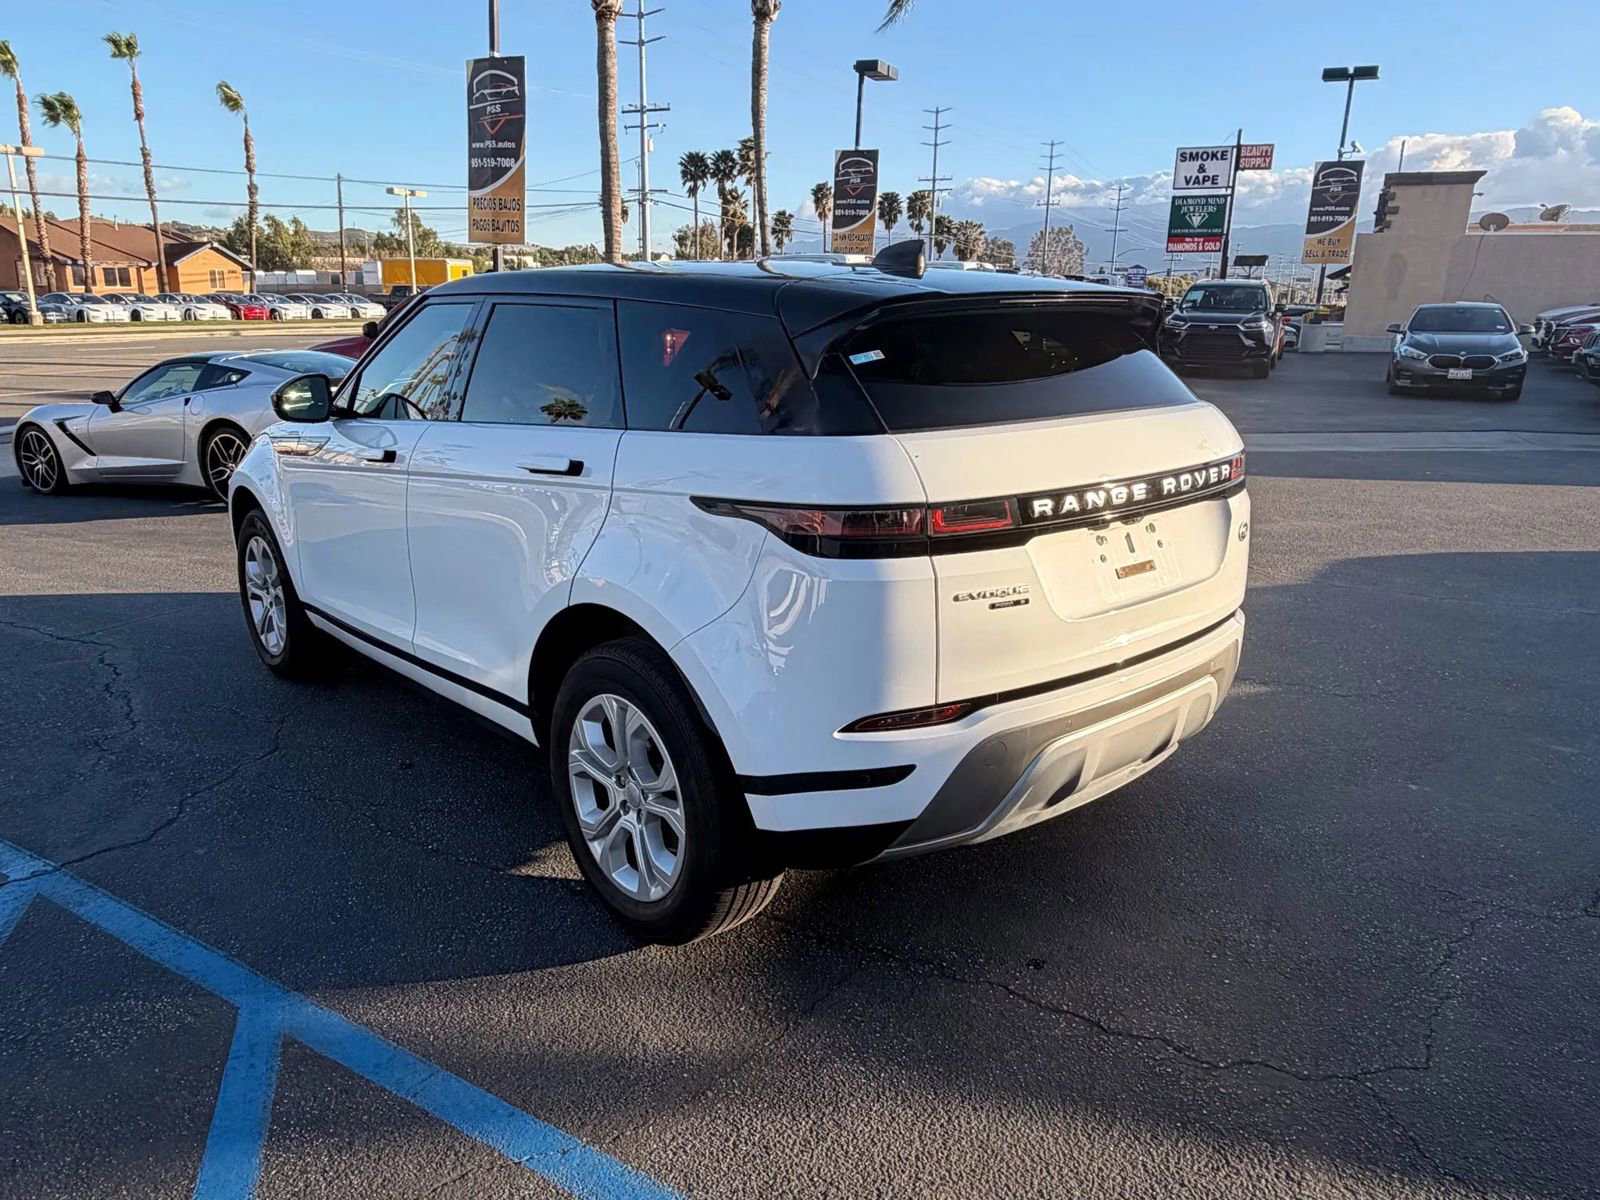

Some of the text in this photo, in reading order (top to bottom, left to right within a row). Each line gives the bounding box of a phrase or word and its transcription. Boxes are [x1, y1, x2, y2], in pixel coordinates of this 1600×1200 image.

[486, 104, 502, 115] PSS
[471, 140, 516, 149] www.PSS.autos
[1179, 150, 1229, 162] SMOKE
[1241, 145, 1273, 157] BEAUTY
[471, 157, 516, 168] 951-519-7008
[1239, 157, 1271, 168] SUPPLY
[1197, 163, 1207, 174] &
[1184, 174, 1220, 186] VAPE
[472, 197, 521, 211] PRECIOS BAJOS
[1175, 197, 1226, 206] DIAMOND MIND
[1180, 205, 1217, 214] JEWELERS
[472, 218, 520, 232] PAGOS BAJITOS
[1167, 241, 1221, 252] DIAMONDS & GOLD
[1317, 237, 1341, 246] WE BUY
[1305, 249, 1349, 258] SELL & TRADE
[1030, 464, 1232, 519] RANGE ROVER
[952, 584, 1030, 602] EVOQUE
